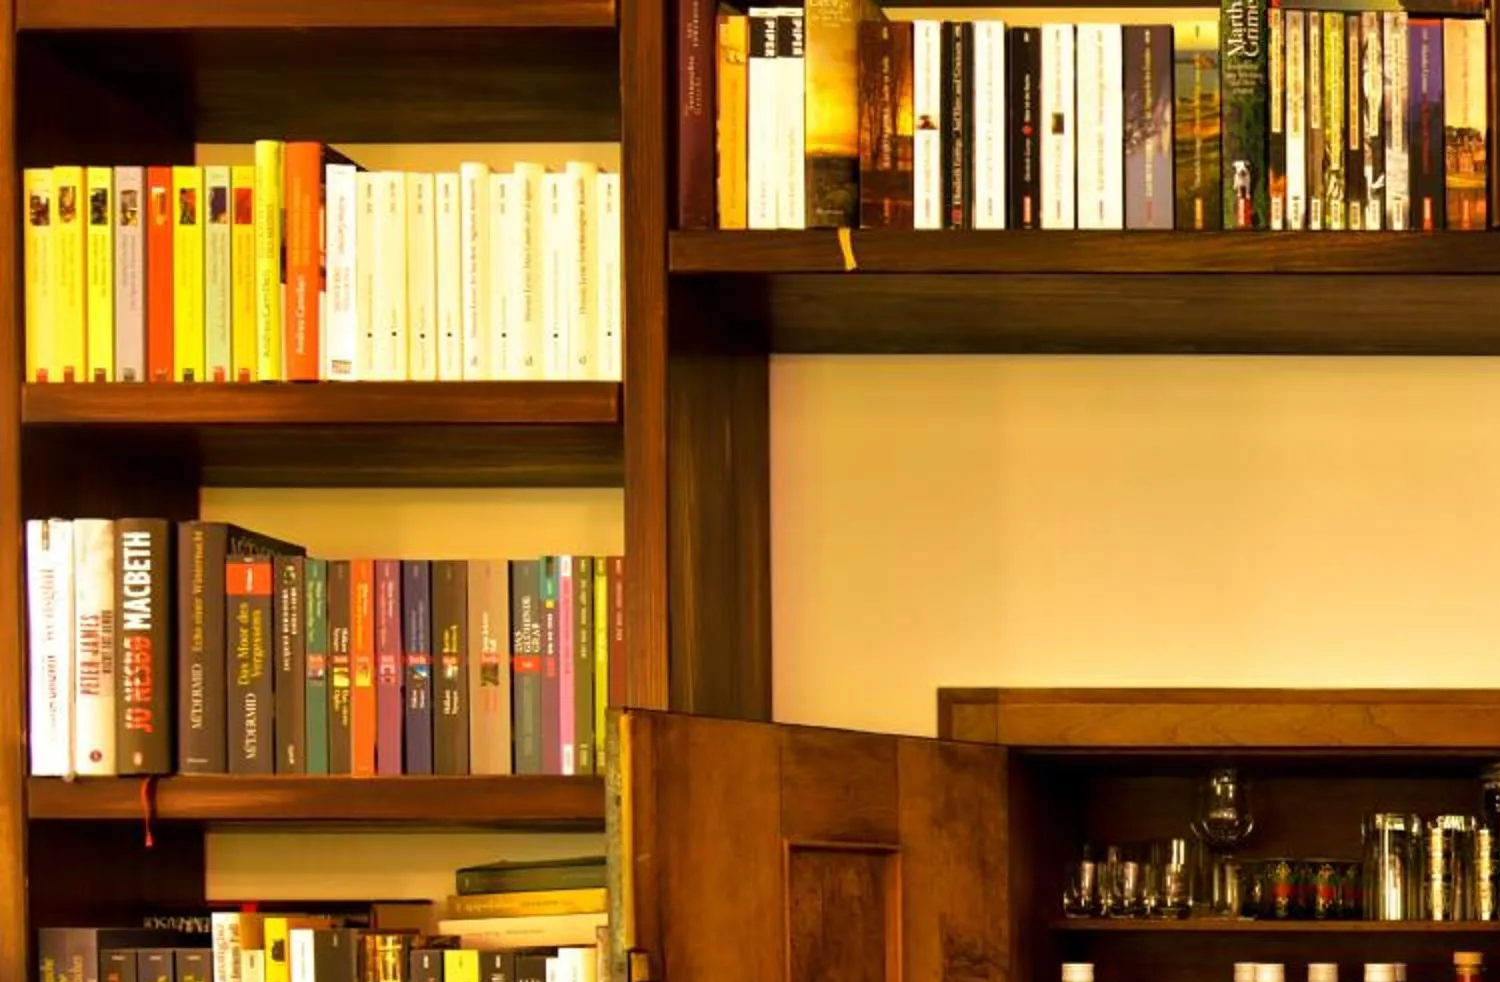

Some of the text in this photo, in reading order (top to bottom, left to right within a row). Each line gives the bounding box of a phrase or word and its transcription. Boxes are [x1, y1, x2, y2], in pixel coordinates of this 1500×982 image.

[78, 614, 100, 696] PETER JAMES
[124, 531, 153, 733] JO MACBETH
[237, 602, 250, 686] Das Moor des
